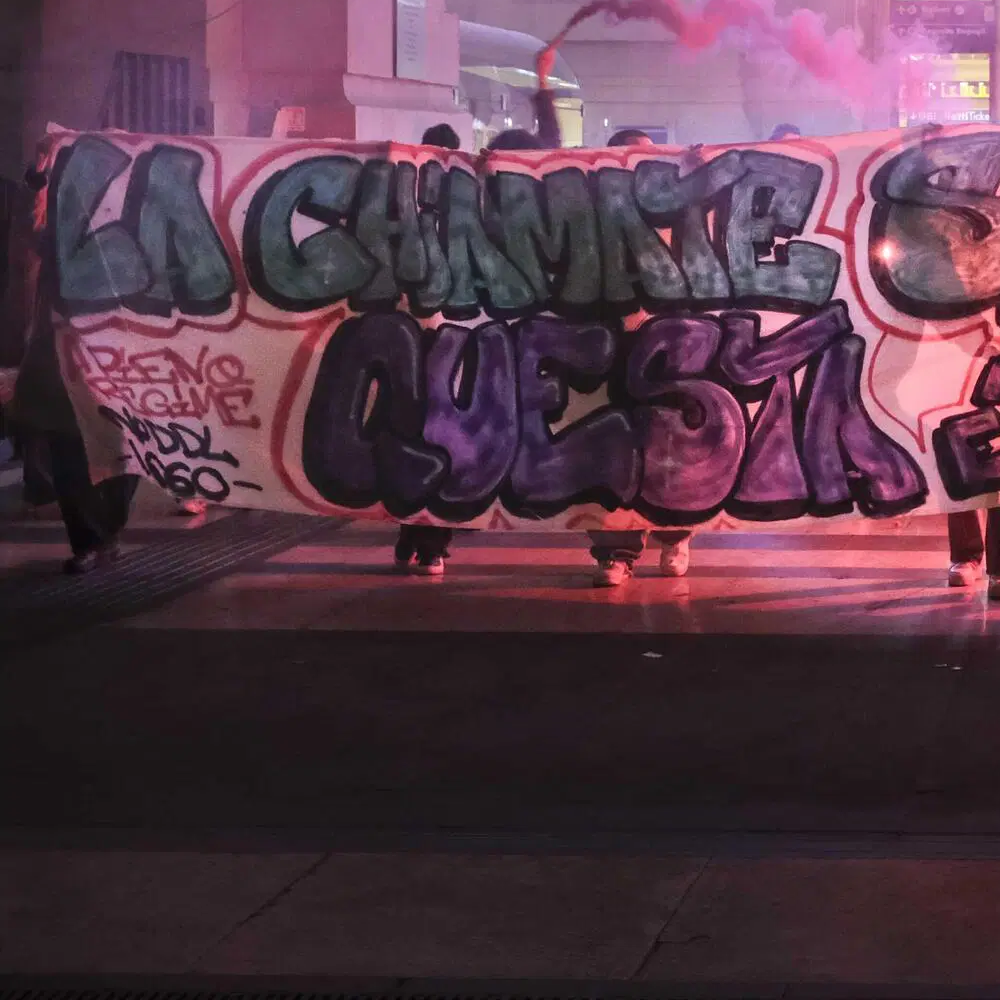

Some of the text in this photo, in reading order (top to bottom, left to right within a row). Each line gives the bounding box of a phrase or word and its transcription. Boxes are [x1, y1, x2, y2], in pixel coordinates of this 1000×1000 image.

[54, 136, 236, 313] LA
[247, 150, 840, 317] CHIAMATE
[87, 345, 255, 389] PIENO
[303, 300, 928, 522] QUESTA
